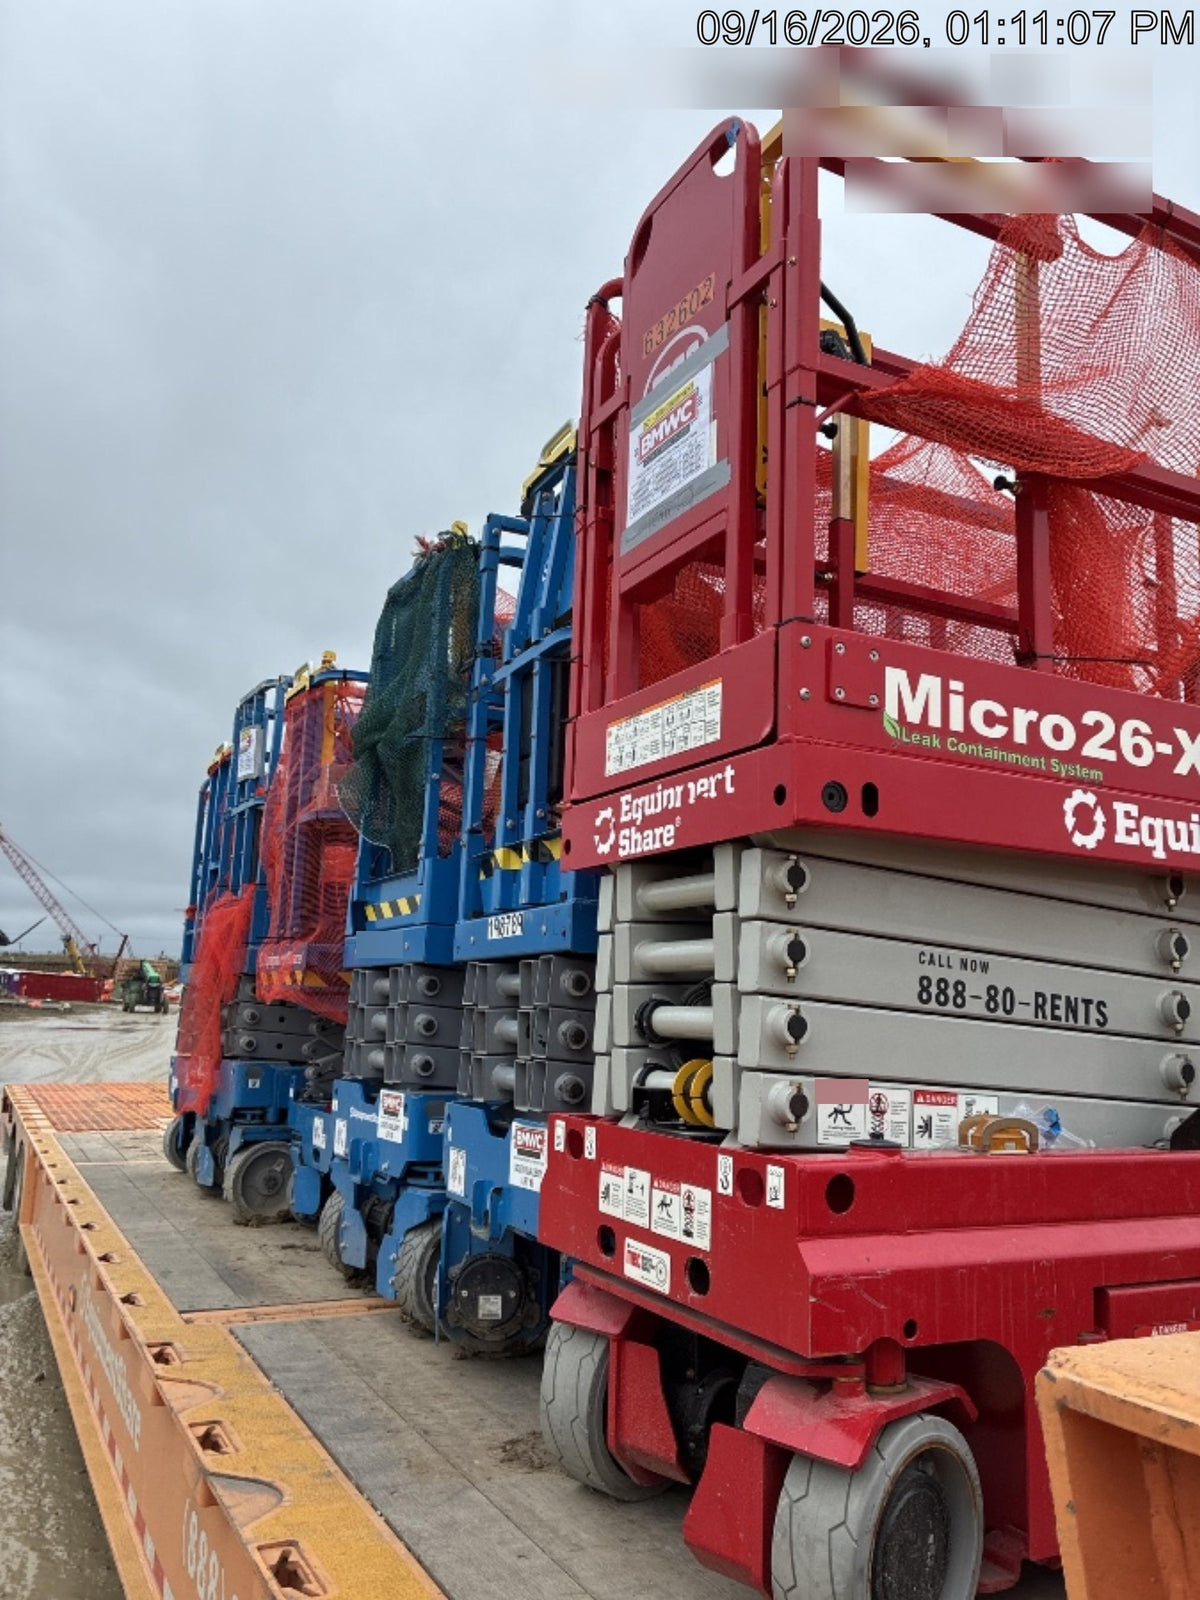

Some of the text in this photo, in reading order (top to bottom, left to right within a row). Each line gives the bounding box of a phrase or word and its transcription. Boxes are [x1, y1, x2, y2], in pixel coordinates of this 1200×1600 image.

[641, 399, 692, 455] BMWC
[902, 727, 1104, 781] Leak Containment System
[919, 951, 990, 974] CALL NOW
[918, 975, 1109, 1028] 888-80-RENTS
[516, 1129, 543, 1149] BMWC
